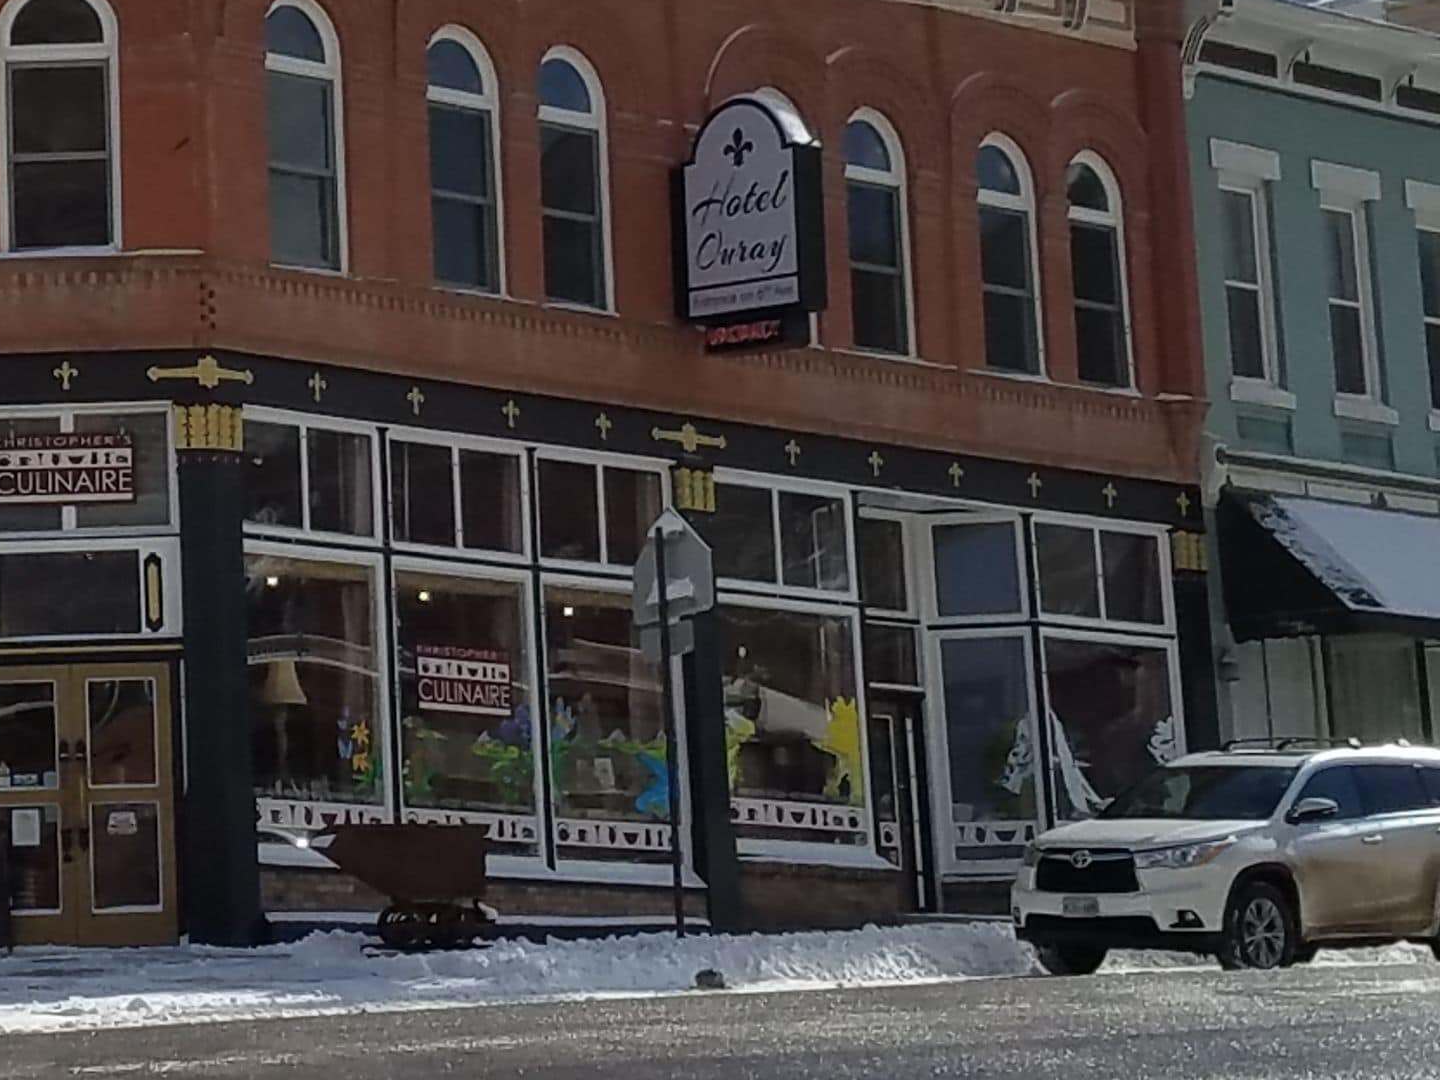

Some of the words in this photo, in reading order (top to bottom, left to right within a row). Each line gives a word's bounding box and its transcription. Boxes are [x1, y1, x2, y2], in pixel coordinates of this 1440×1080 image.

[692, 169, 789, 225] Hotel
[695, 229, 788, 273] Ouray
[418, 678, 511, 708] CULINAIRE
